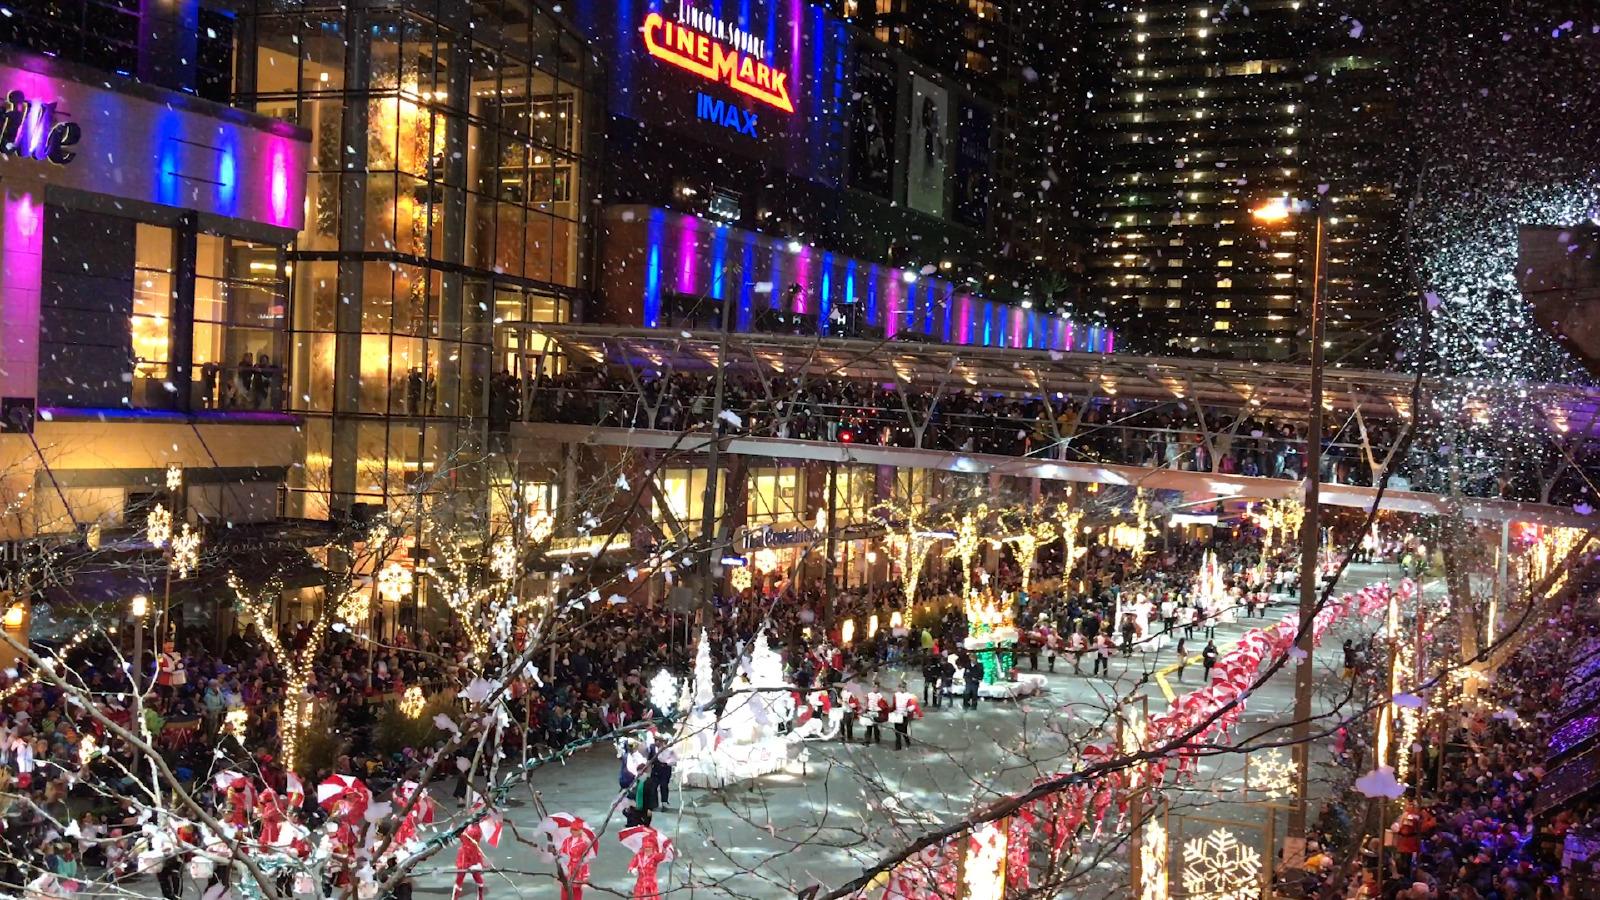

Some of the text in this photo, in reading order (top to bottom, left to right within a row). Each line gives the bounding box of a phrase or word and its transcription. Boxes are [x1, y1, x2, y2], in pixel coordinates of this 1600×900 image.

[679, 0, 765, 60] LINCOLN SQUARE
[644, 12, 794, 113] CINEMARK
[697, 92, 758, 138] IMAX
